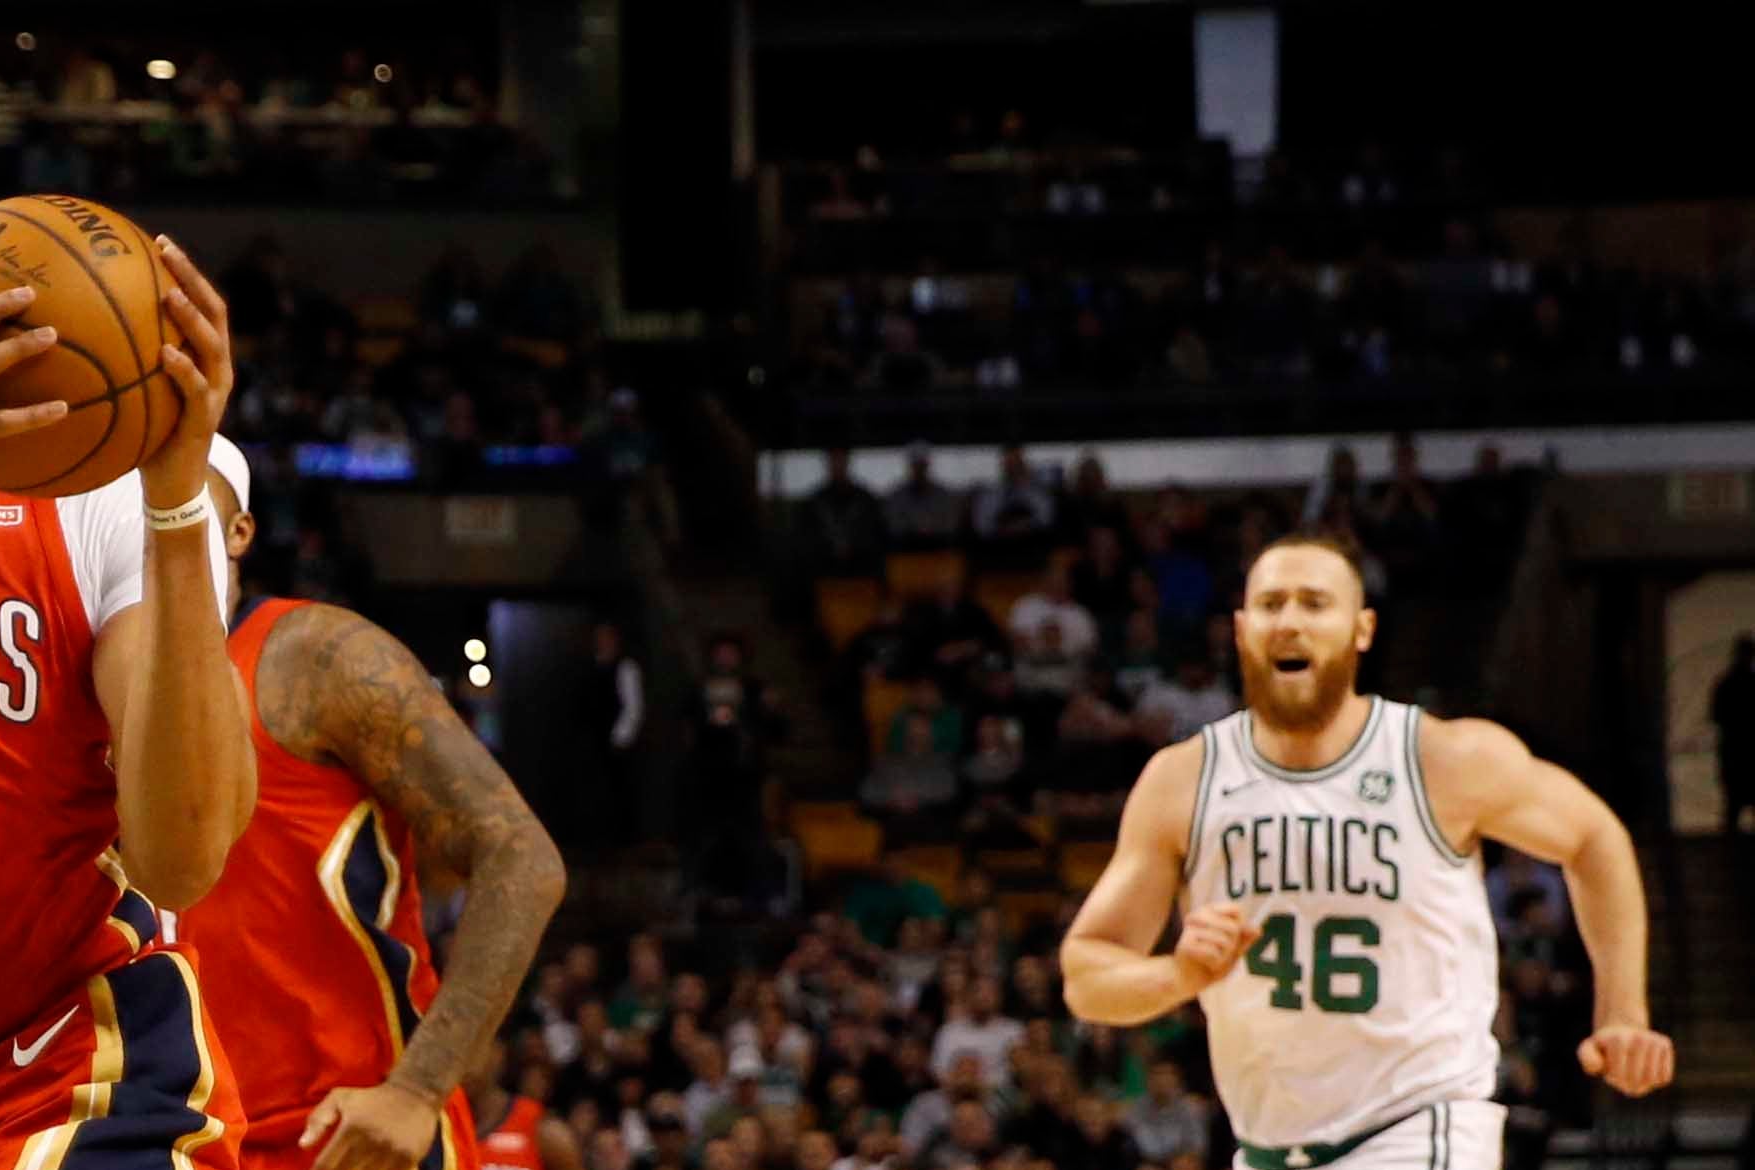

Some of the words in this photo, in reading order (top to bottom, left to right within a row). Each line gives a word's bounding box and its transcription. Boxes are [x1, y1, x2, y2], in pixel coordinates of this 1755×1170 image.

[34, 195, 132, 256] DING
[1222, 815, 1399, 901] CELTICS
[1247, 912, 1381, 1014] 46
